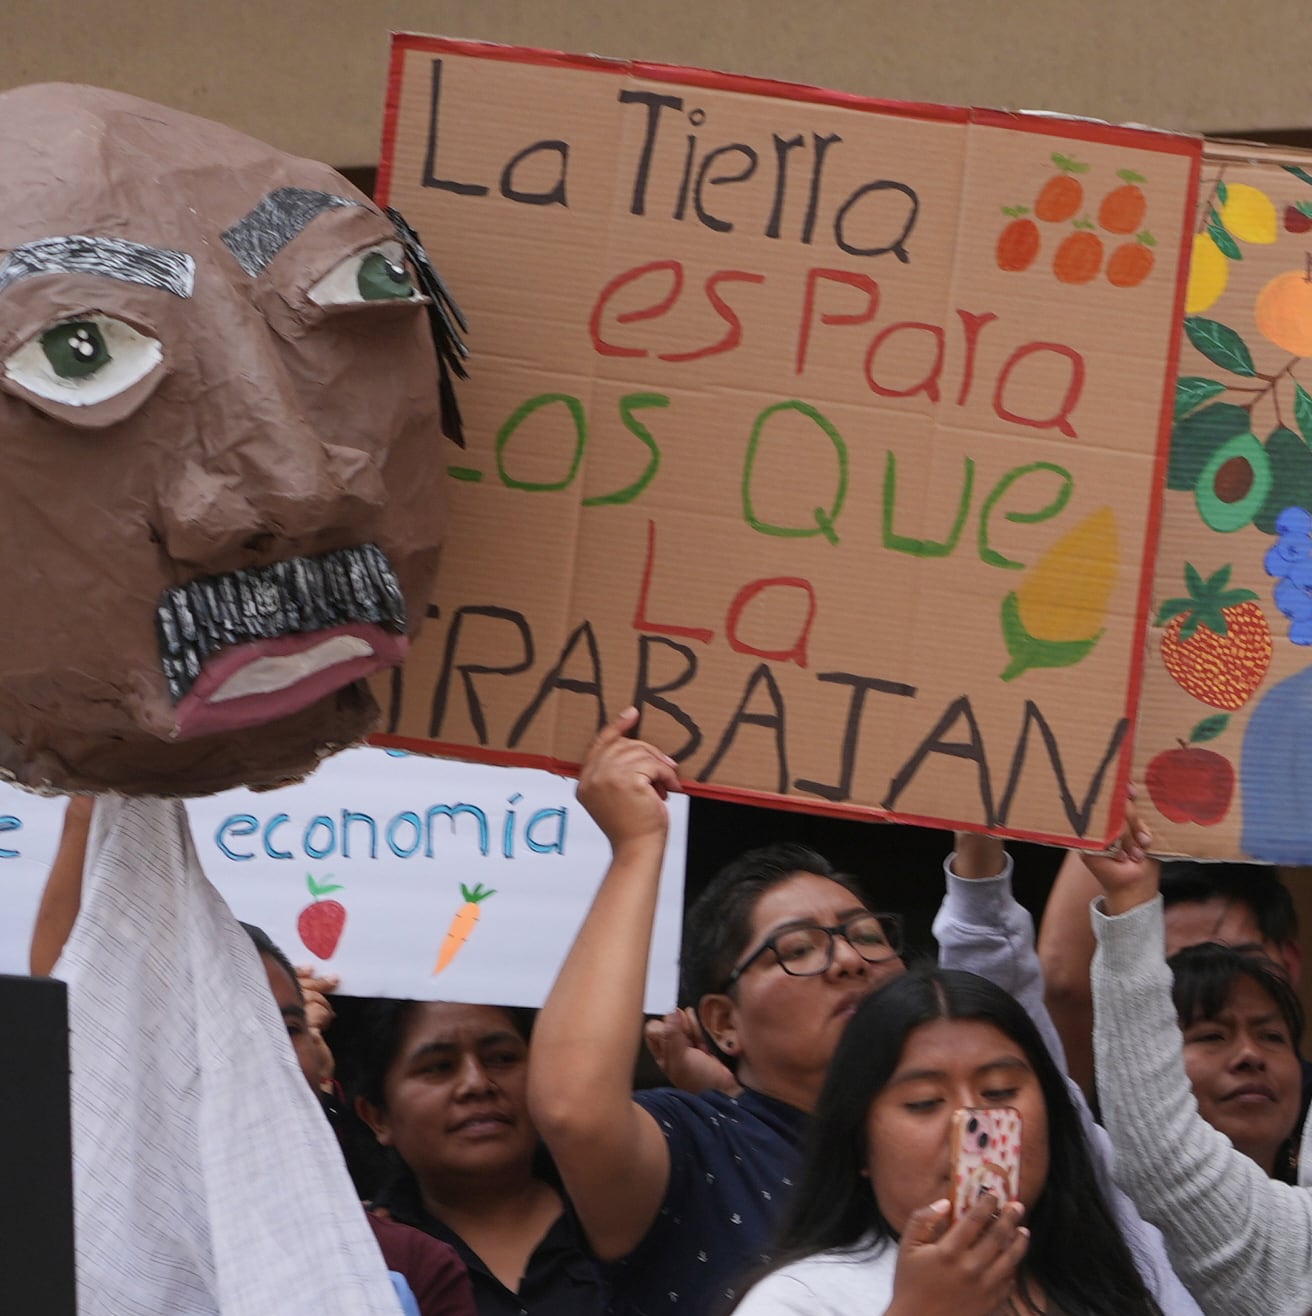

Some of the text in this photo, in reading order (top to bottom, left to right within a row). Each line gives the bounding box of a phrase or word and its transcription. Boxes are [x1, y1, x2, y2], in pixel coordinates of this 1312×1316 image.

[422, 59, 921, 266] La Tierra
[632, 518, 818, 669] La
[214, 793, 570, 862] economía
